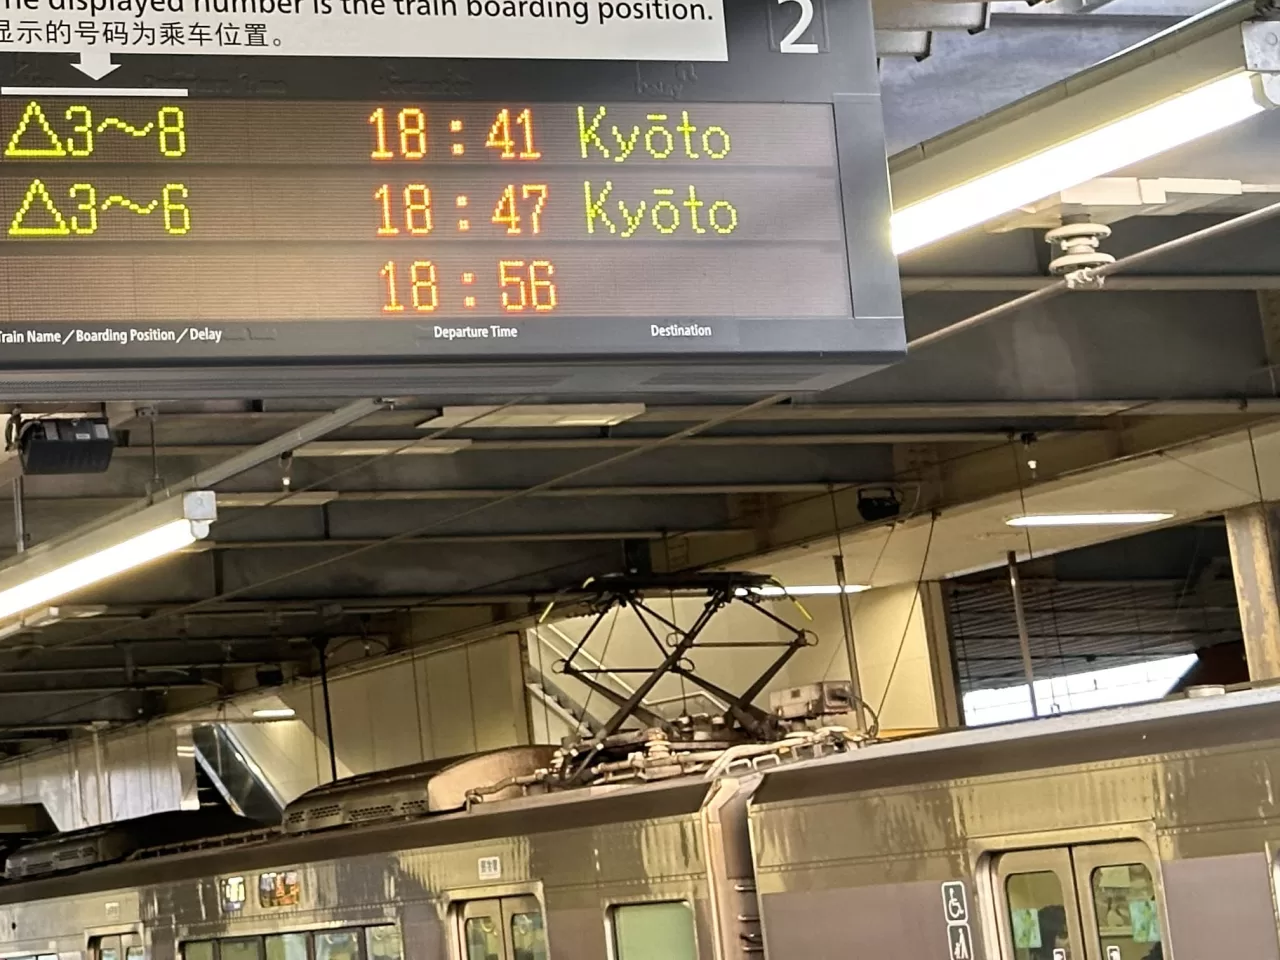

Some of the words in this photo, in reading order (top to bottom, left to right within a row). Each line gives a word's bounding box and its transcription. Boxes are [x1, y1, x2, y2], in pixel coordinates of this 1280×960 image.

[576, 105, 733, 163] Kyōto
[583, 180, 739, 238] Kyōto
[433, 325, 488, 340] Departure
[490, 325, 518, 338] Time
[650, 324, 712, 337] Destination
